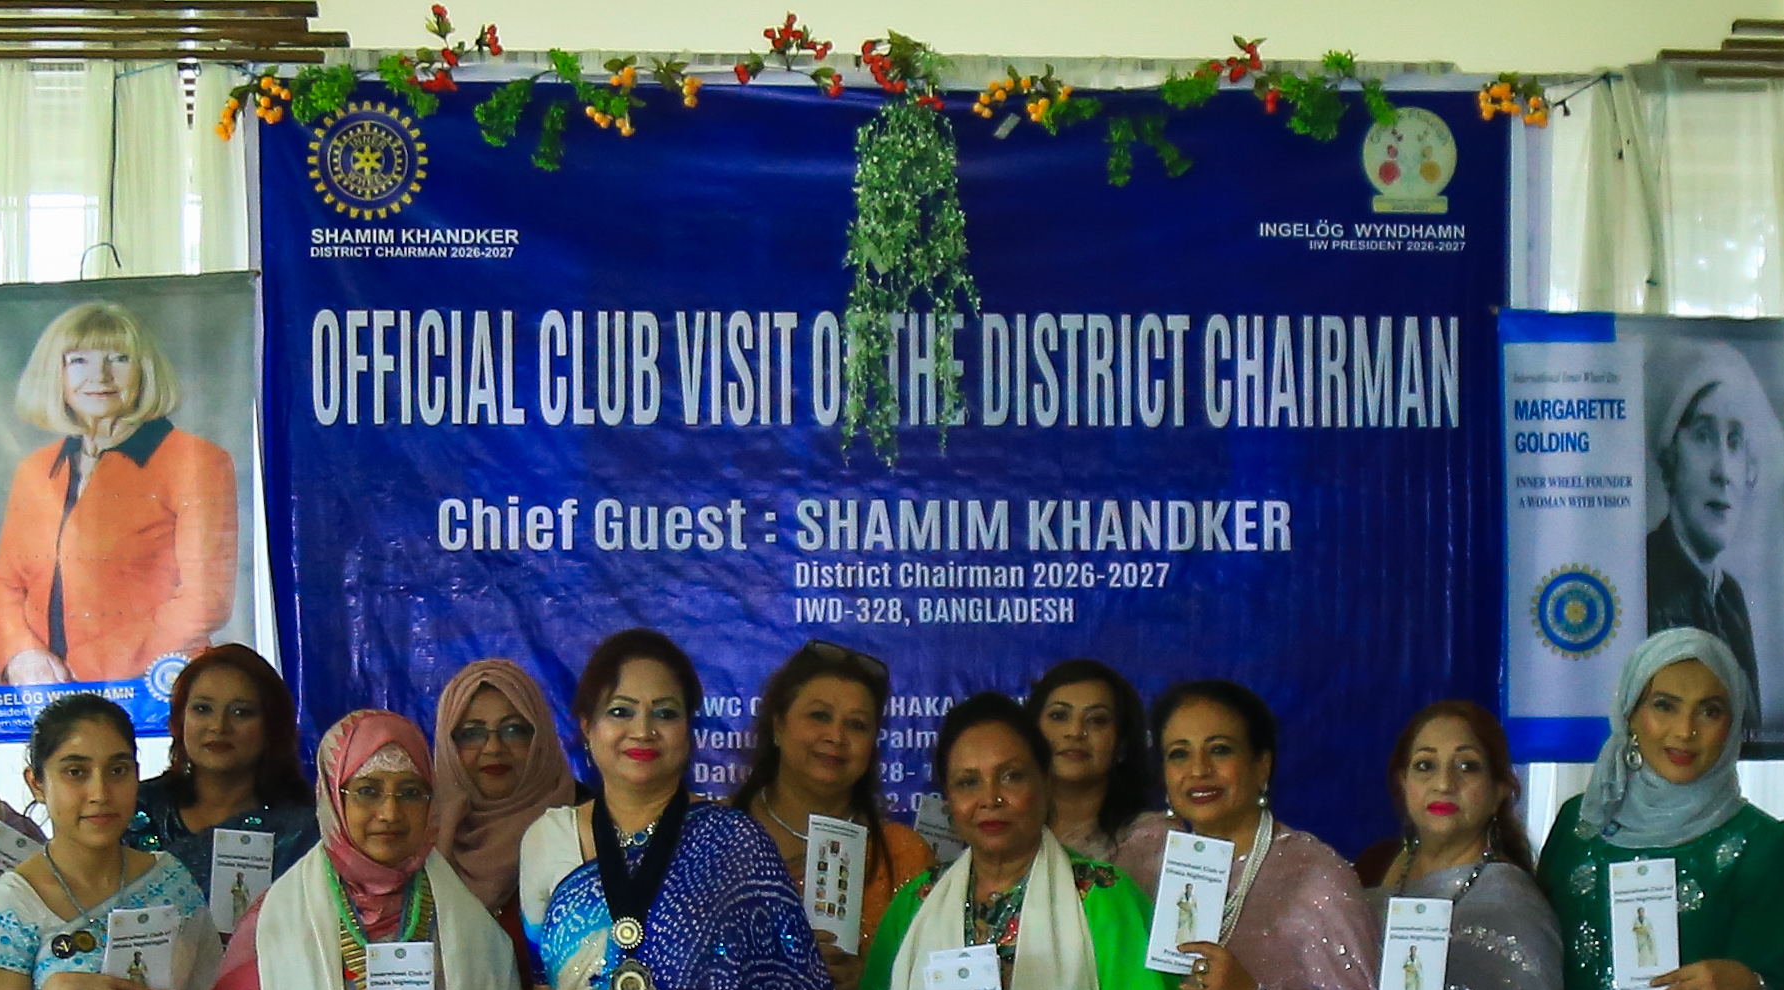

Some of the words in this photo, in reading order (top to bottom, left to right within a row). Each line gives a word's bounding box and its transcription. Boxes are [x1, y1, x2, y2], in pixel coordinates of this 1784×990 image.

[311, 228, 395, 245] SHAMIM
[401, 228, 520, 245] KHANDKER
[1260, 219, 1344, 238] INGELÖG
[1355, 223, 1466, 239] WYNDHAMN
[310, 246, 372, 258] DISTRICT
[375, 246, 448, 258] CHAIRMAN
[450, 246, 515, 258] 2026-2027
[1332, 240, 1403, 251] PRESIDENT
[1407, 241, 1466, 252] 2026-2027
[312, 308, 526, 427] OFFICIAL
[538, 308, 661, 427] CLUB
[675, 309, 799, 427] VISIT
[812, 310, 870, 427] O
[982, 312, 1191, 429] DISTRICT
[1204, 312, 1461, 429] CHAIRMAN
[1514, 398, 1627, 421] MARGARETTE
[1514, 431, 1591, 454] GOLDING
[1516, 475, 1546, 489] INNER
[1547, 475, 1584, 489] WHEEL
[1586, 475, 1633, 489] FOUNDER
[437, 495, 580, 552] Chief
[593, 498, 748, 552] Guest
[764, 510, 778, 544] :
[795, 498, 1010, 553] SHAMIM
[1027, 498, 1293, 553] KHANDKER
[795, 561, 892, 589] District
[898, 561, 1025, 589] Chairman
[1033, 561, 1170, 590] 2026-2027
[795, 598, 911, 628] IWD-328,
[918, 597, 1075, 624] BANGLADESH
